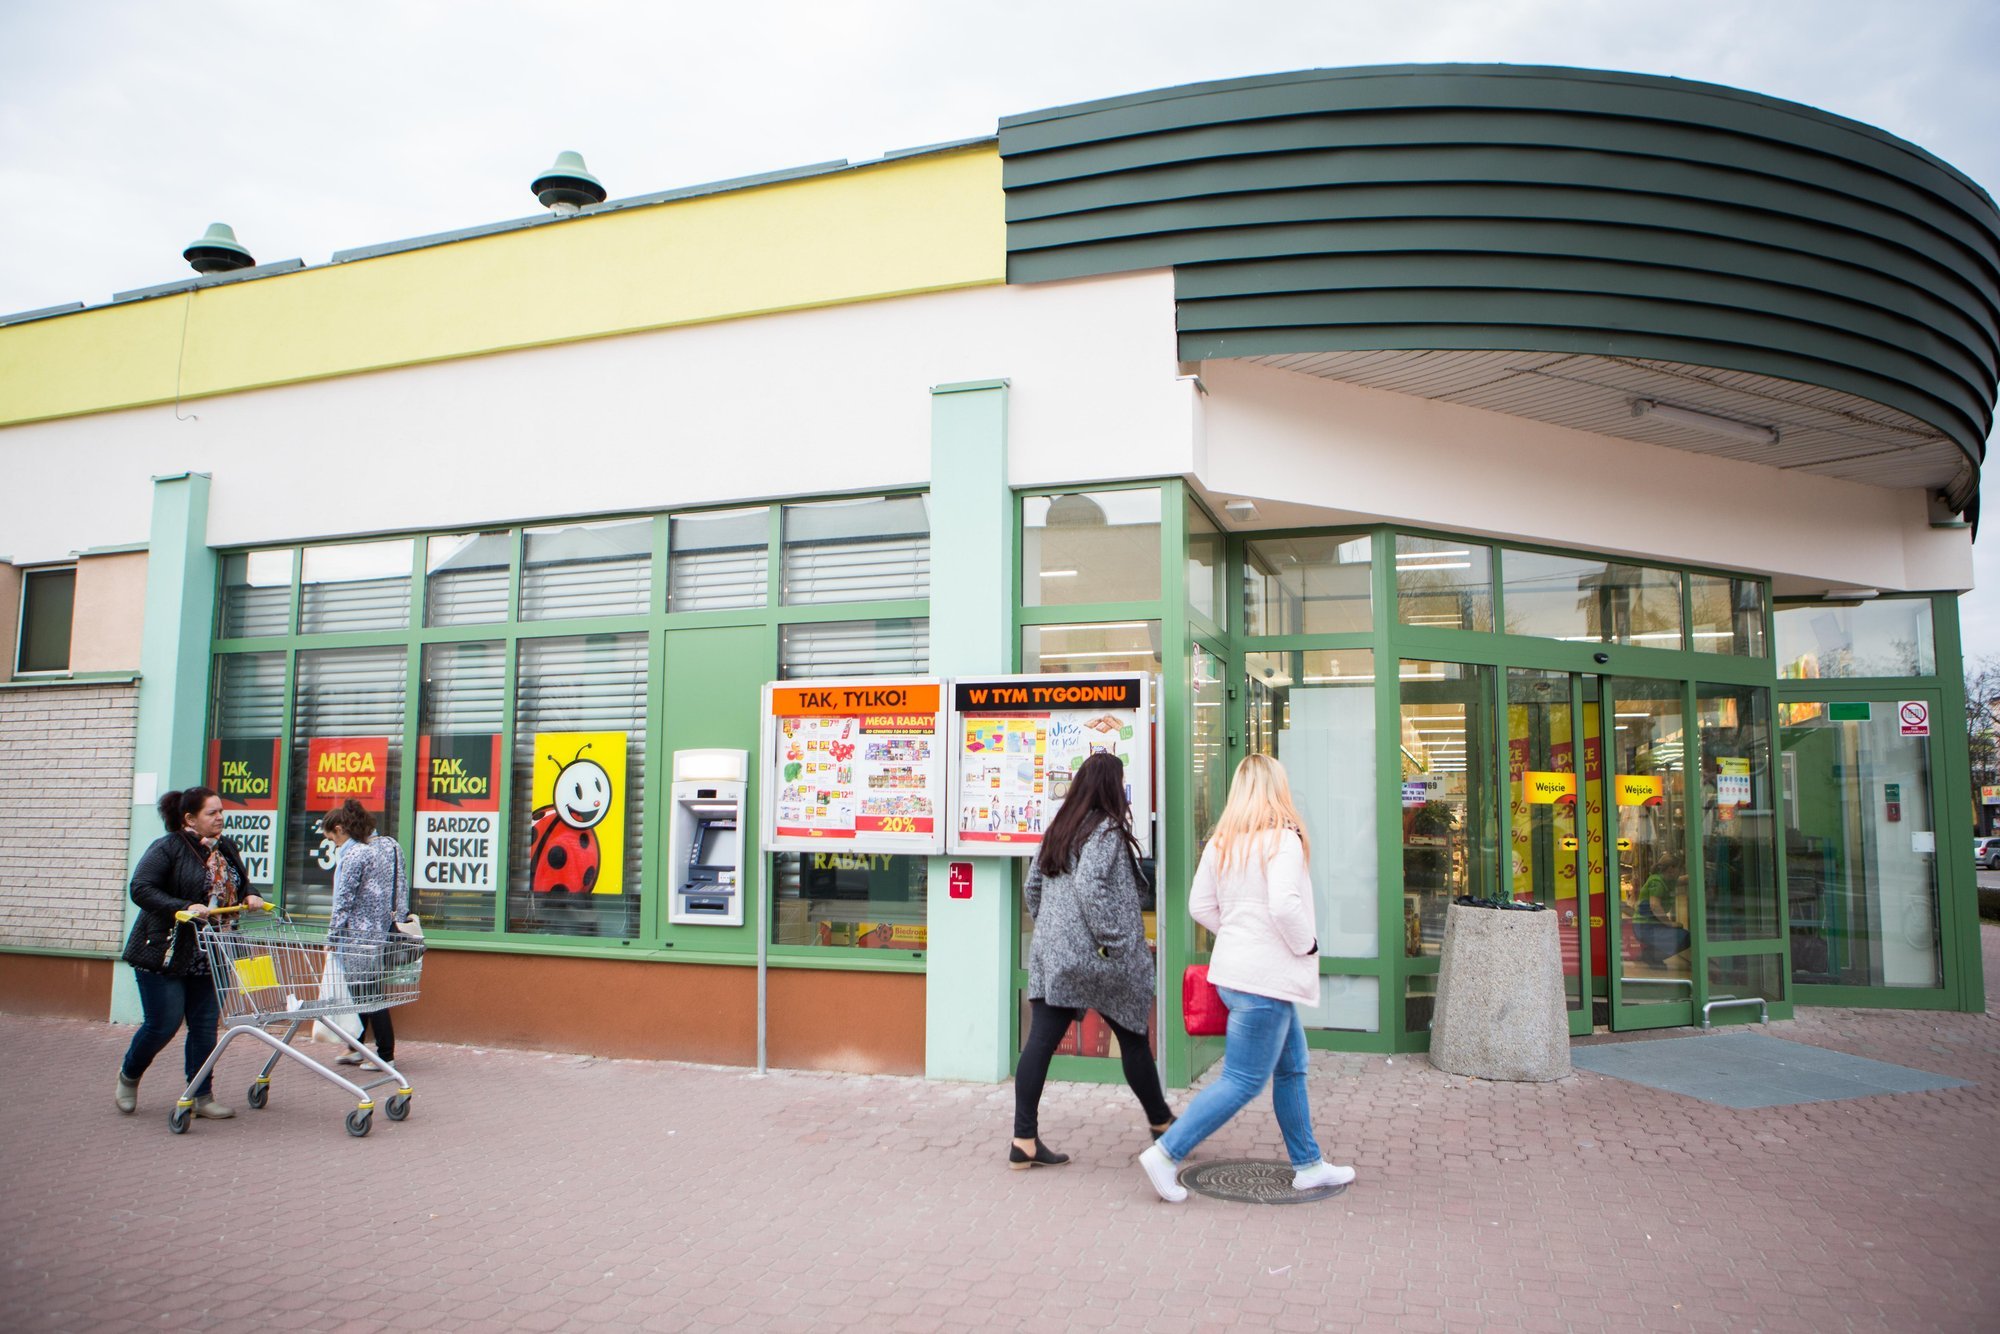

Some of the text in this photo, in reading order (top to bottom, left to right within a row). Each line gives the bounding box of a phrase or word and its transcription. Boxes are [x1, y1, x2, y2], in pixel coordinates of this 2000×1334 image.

[799, 690, 907, 710] TAK, TYLKO!
[969, 686, 1126, 704] W TYM TYGODNIU
[865, 716, 935, 726] MEGA RABATY
[222, 761, 251, 778] TAK,
[318, 751, 376, 773] MEGA
[432, 758, 467, 777] TAK,
[221, 778, 269, 794] TYLKO!
[317, 777, 376, 793] RABATY
[432, 777, 487, 794] TYLKO!
[1536, 782, 1566, 794] Wejście
[1625, 785, 1653, 796] Wejście
[223, 815, 271, 830] ARDZO
[427, 817, 490, 833] BARDZO
[878, 817, 915, 832] -20%
[230, 834, 269, 853] ISKIE
[426, 838, 489, 858] NISKIE
[814, 852, 893, 870] RABATY
[425, 861, 488, 885] CENY!
[895, 927, 927, 936] Biedronk
